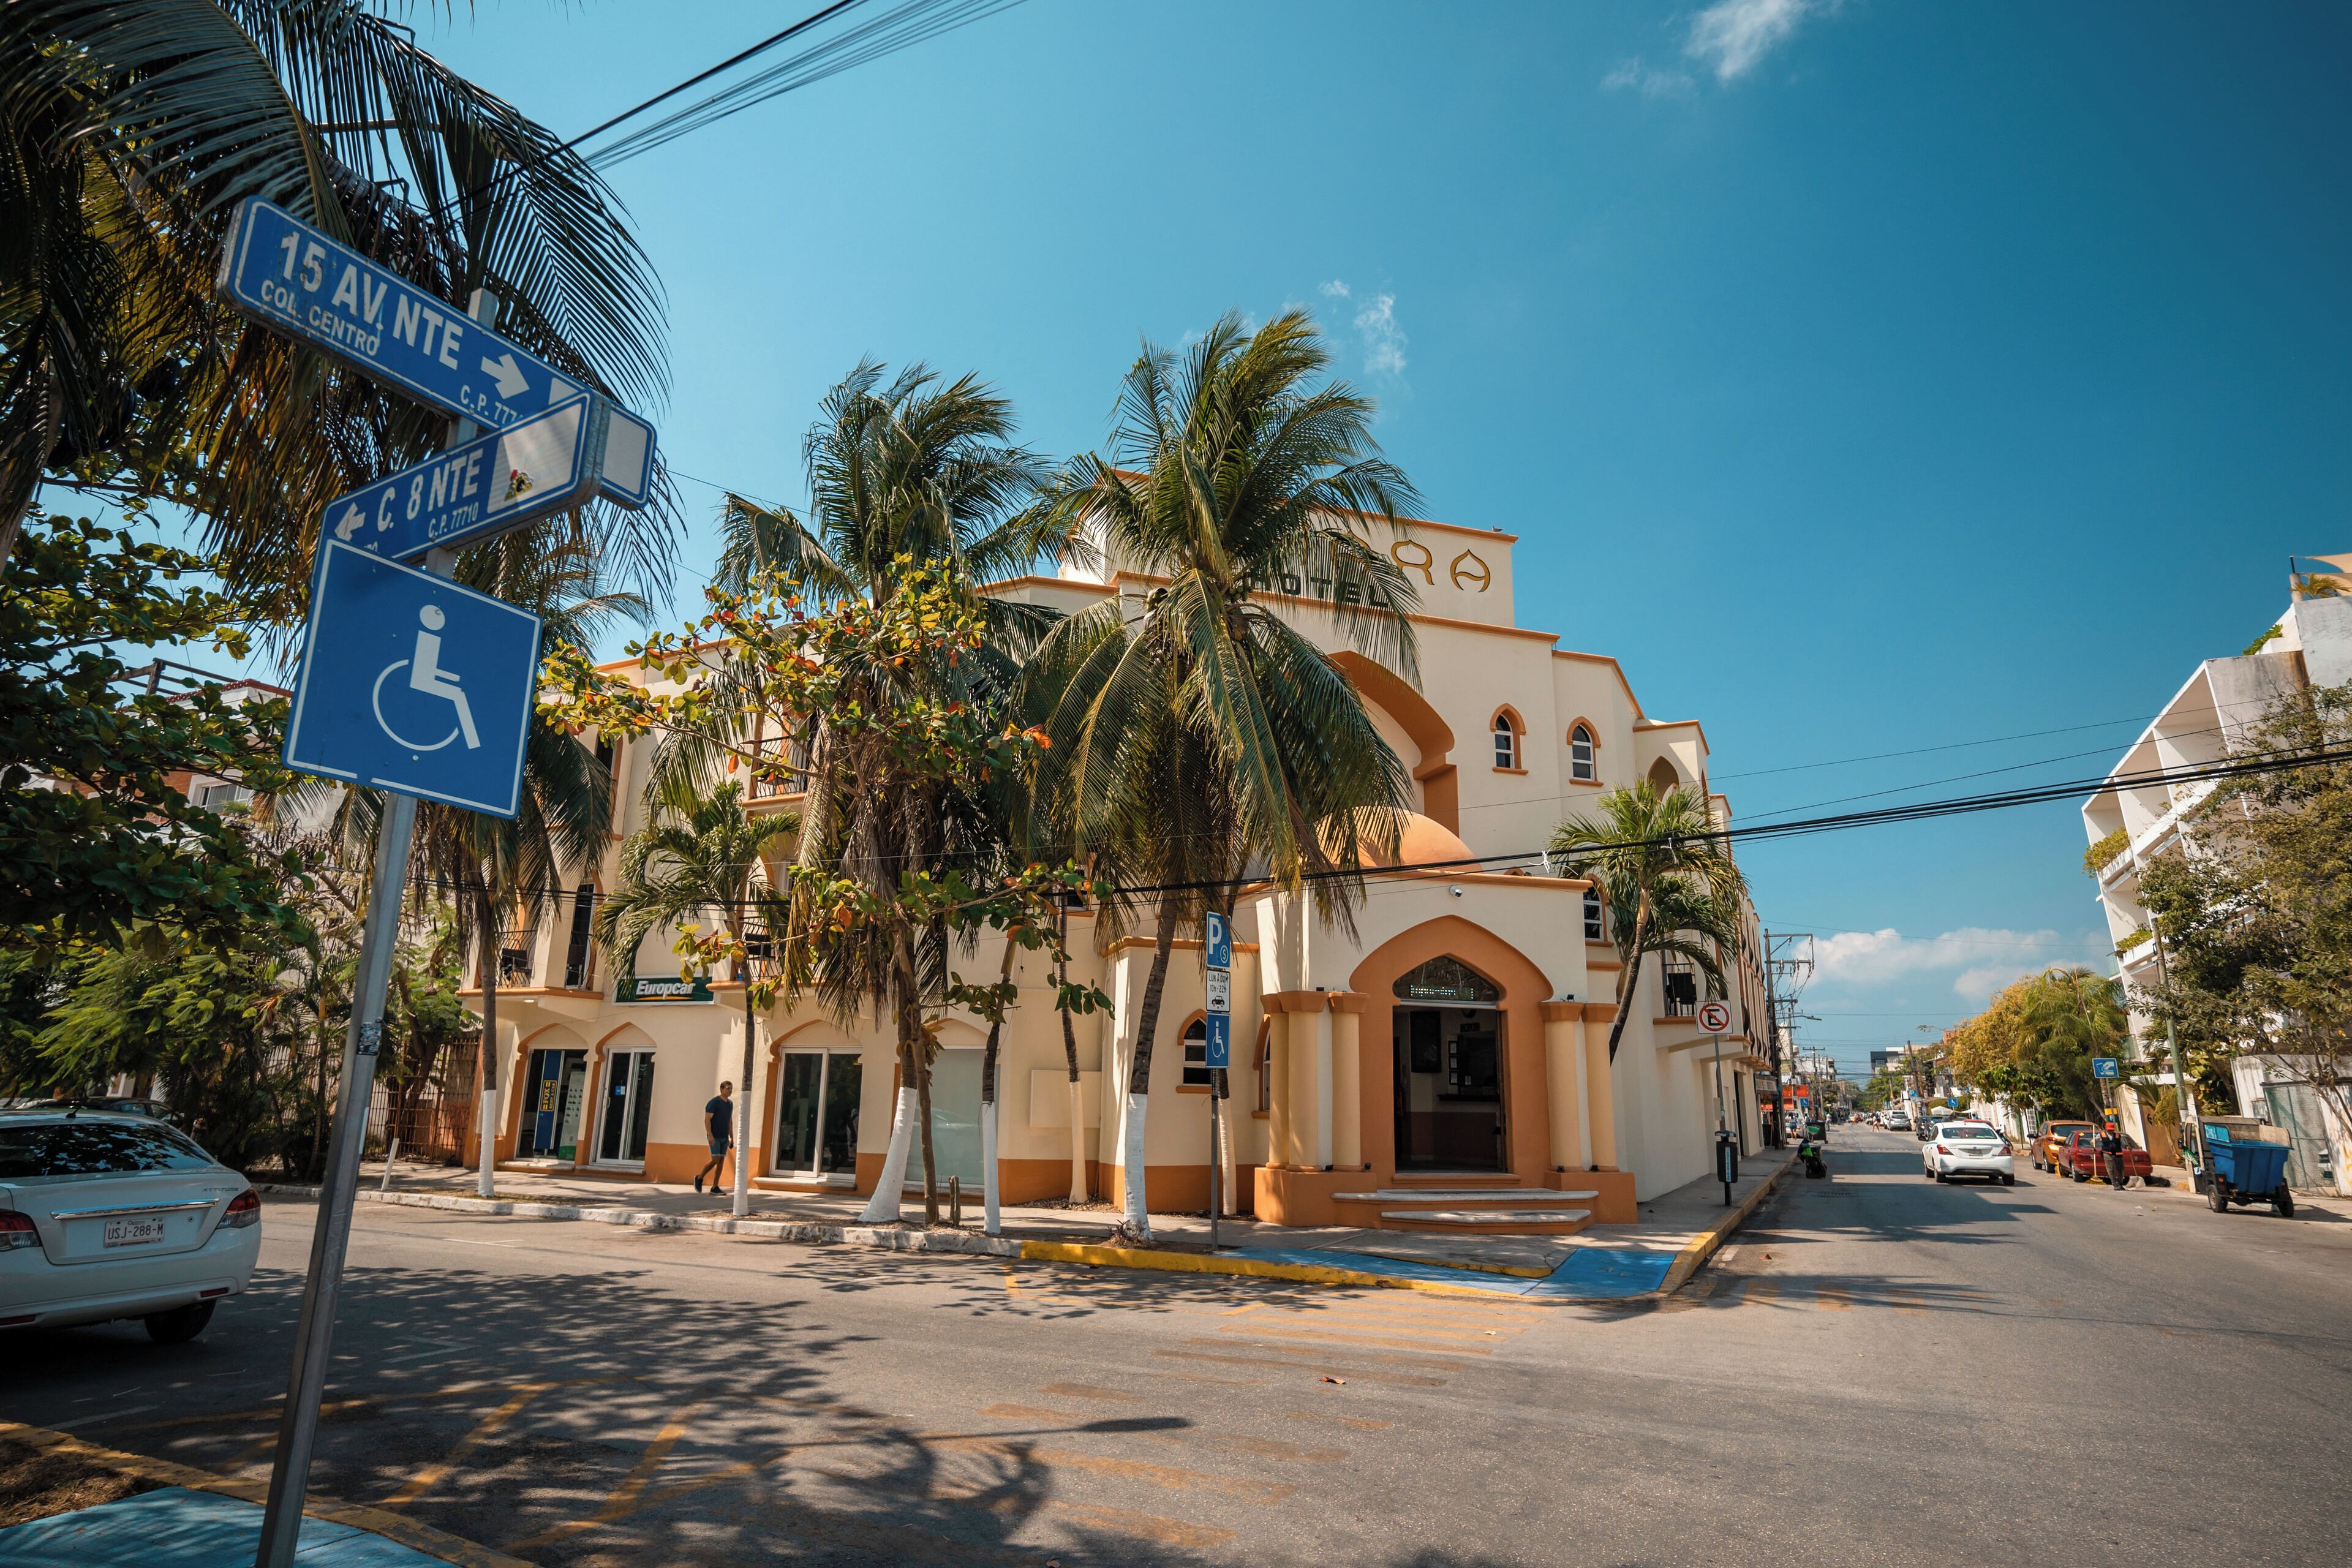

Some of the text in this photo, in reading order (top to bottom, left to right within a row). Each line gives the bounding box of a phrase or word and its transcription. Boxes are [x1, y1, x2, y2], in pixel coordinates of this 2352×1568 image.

[281, 231, 326, 292] 15
[393, 293, 463, 371] NTE
[262, 280, 380, 356] COL. CENTRO
[494, 402, 523, 424] 777
[377, 448, 483, 532] C. 8 NTE
[451, 501, 479, 529] 77710
[1209, 917, 1222, 954] P
[636, 981, 696, 1000] Europcar
[1708, 1008, 1722, 1026] E
[108, 1224, 164, 1240] USJ-288-M
